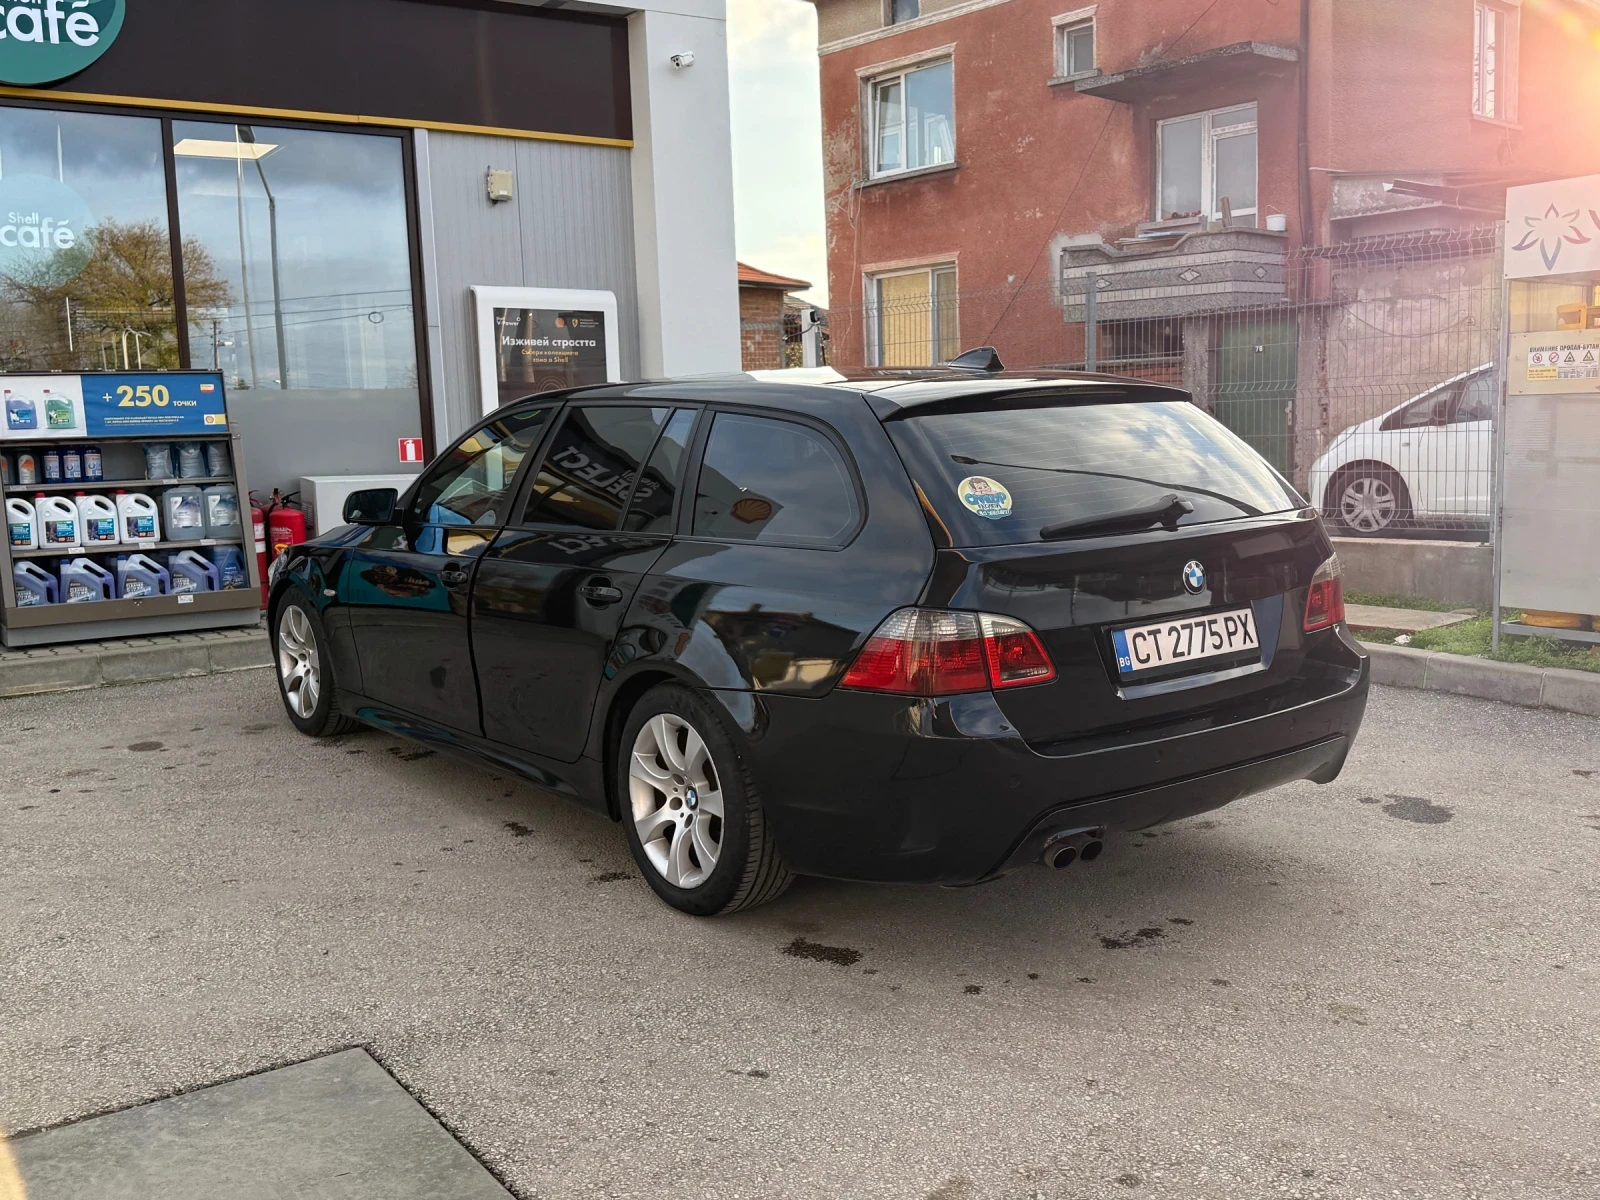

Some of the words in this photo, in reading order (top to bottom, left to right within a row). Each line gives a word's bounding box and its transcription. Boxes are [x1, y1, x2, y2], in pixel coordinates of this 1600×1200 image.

[0, 0, 100, 47] afé
[8, 211, 39, 225] Shell
[0, 217, 75, 249] café
[502, 336, 549, 347] Изживей
[552, 339, 596, 349] страстта
[116, 384, 170, 407] 250
[1132, 628, 1163, 664] CT
[1167, 618, 1224, 659] 2775
[1223, 613, 1254, 648] PX
[1119, 657, 1131, 667] BG
